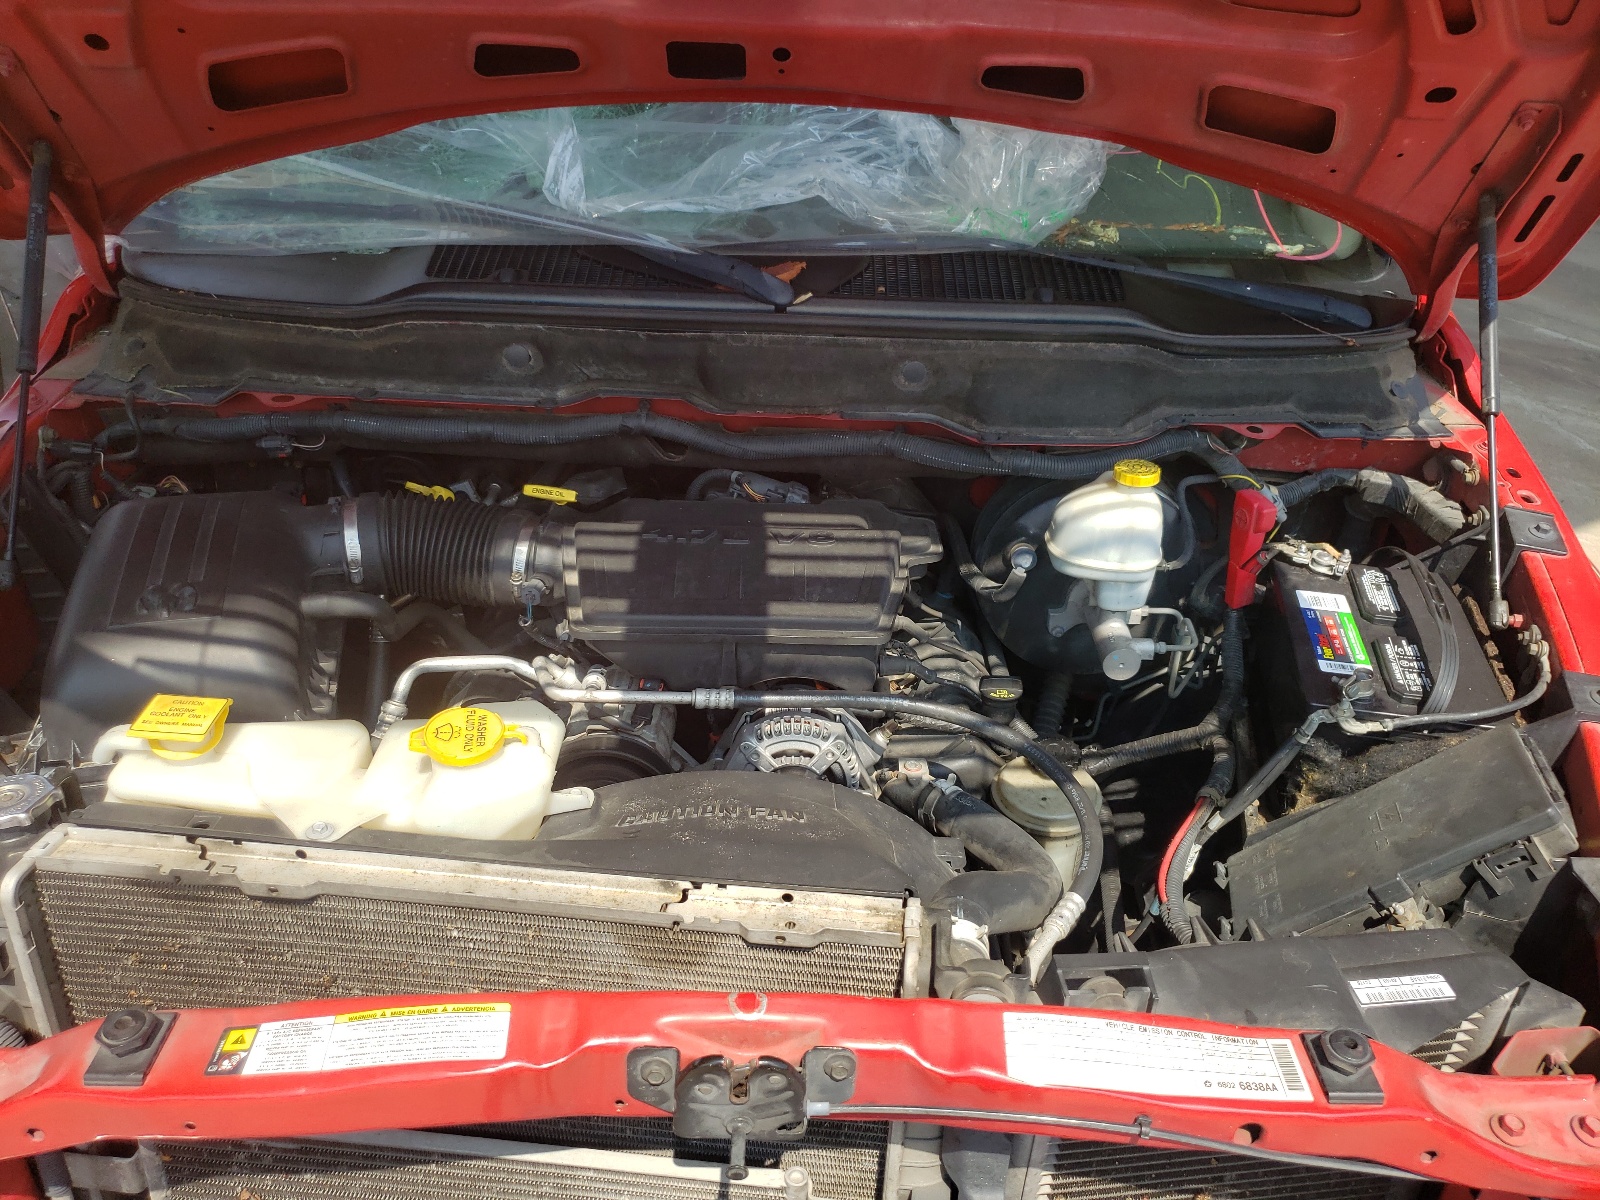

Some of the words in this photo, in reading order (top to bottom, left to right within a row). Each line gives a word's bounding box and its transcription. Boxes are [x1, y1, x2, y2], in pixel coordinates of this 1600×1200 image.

[531, 487, 554, 496] ENGINE
[554, 490, 566, 498] OIL
[465, 709, 476, 732] FLUID
[476, 714, 487, 747] WASHER
[463, 733, 474, 753] ONLY
[749, 807, 806, 823] FAN
[348, 1012, 378, 1022] WARNING
[390, 1009, 406, 1017] MISE
[417, 1007, 438, 1015] GARDE
[281, 1020, 313, 1028] ATTENTION
[1105, 1021, 1135, 1032] VEHICLE
[1138, 1025, 1174, 1036] EMISSION
[1176, 1029, 1207, 1040] CONTROL
[1211, 1034, 1259, 1046] INFORMATION
[1239, 1081, 1279, 1092] 6838AA
